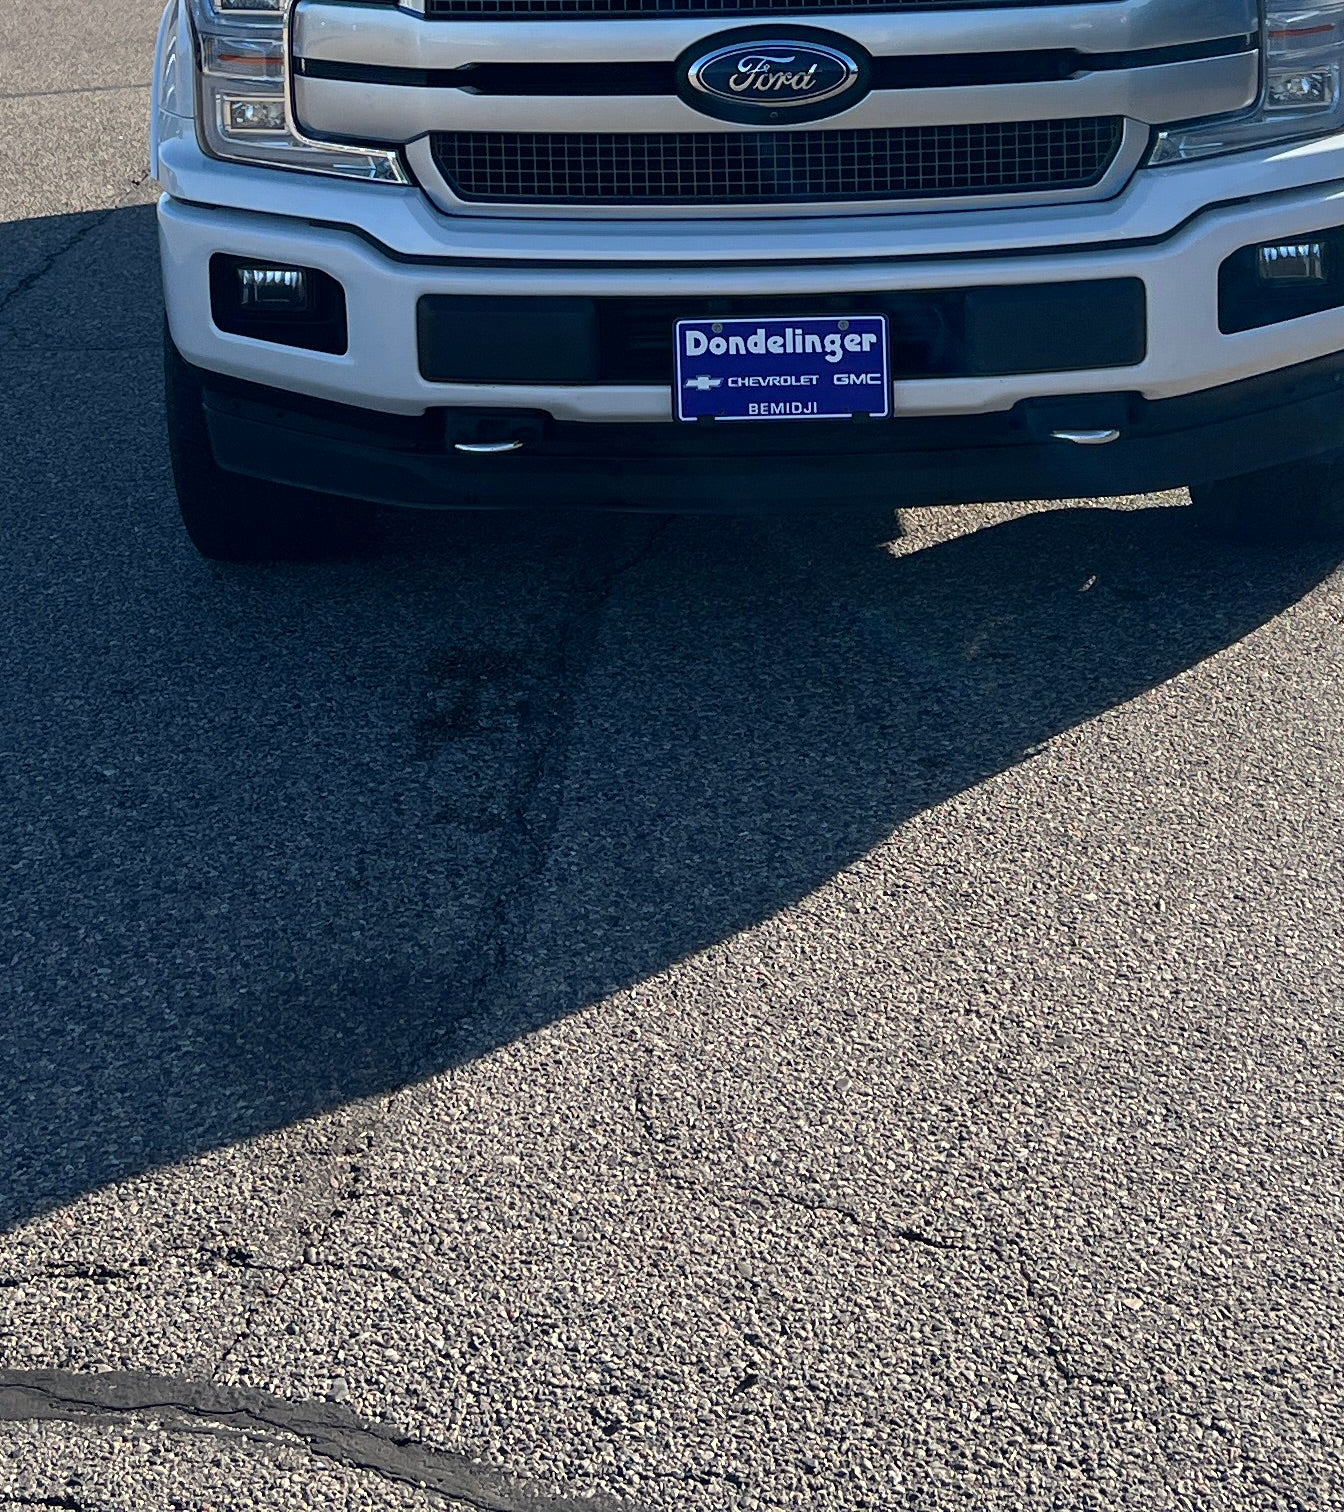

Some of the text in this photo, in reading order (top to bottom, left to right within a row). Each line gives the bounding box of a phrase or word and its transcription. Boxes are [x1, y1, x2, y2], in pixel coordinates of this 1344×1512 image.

[729, 55, 818, 92] Ford
[685, 328, 877, 363] Dondelinger
[728, 373, 882, 387] CHEVROLET GMC
[748, 401, 818, 415] BEMIDJI
